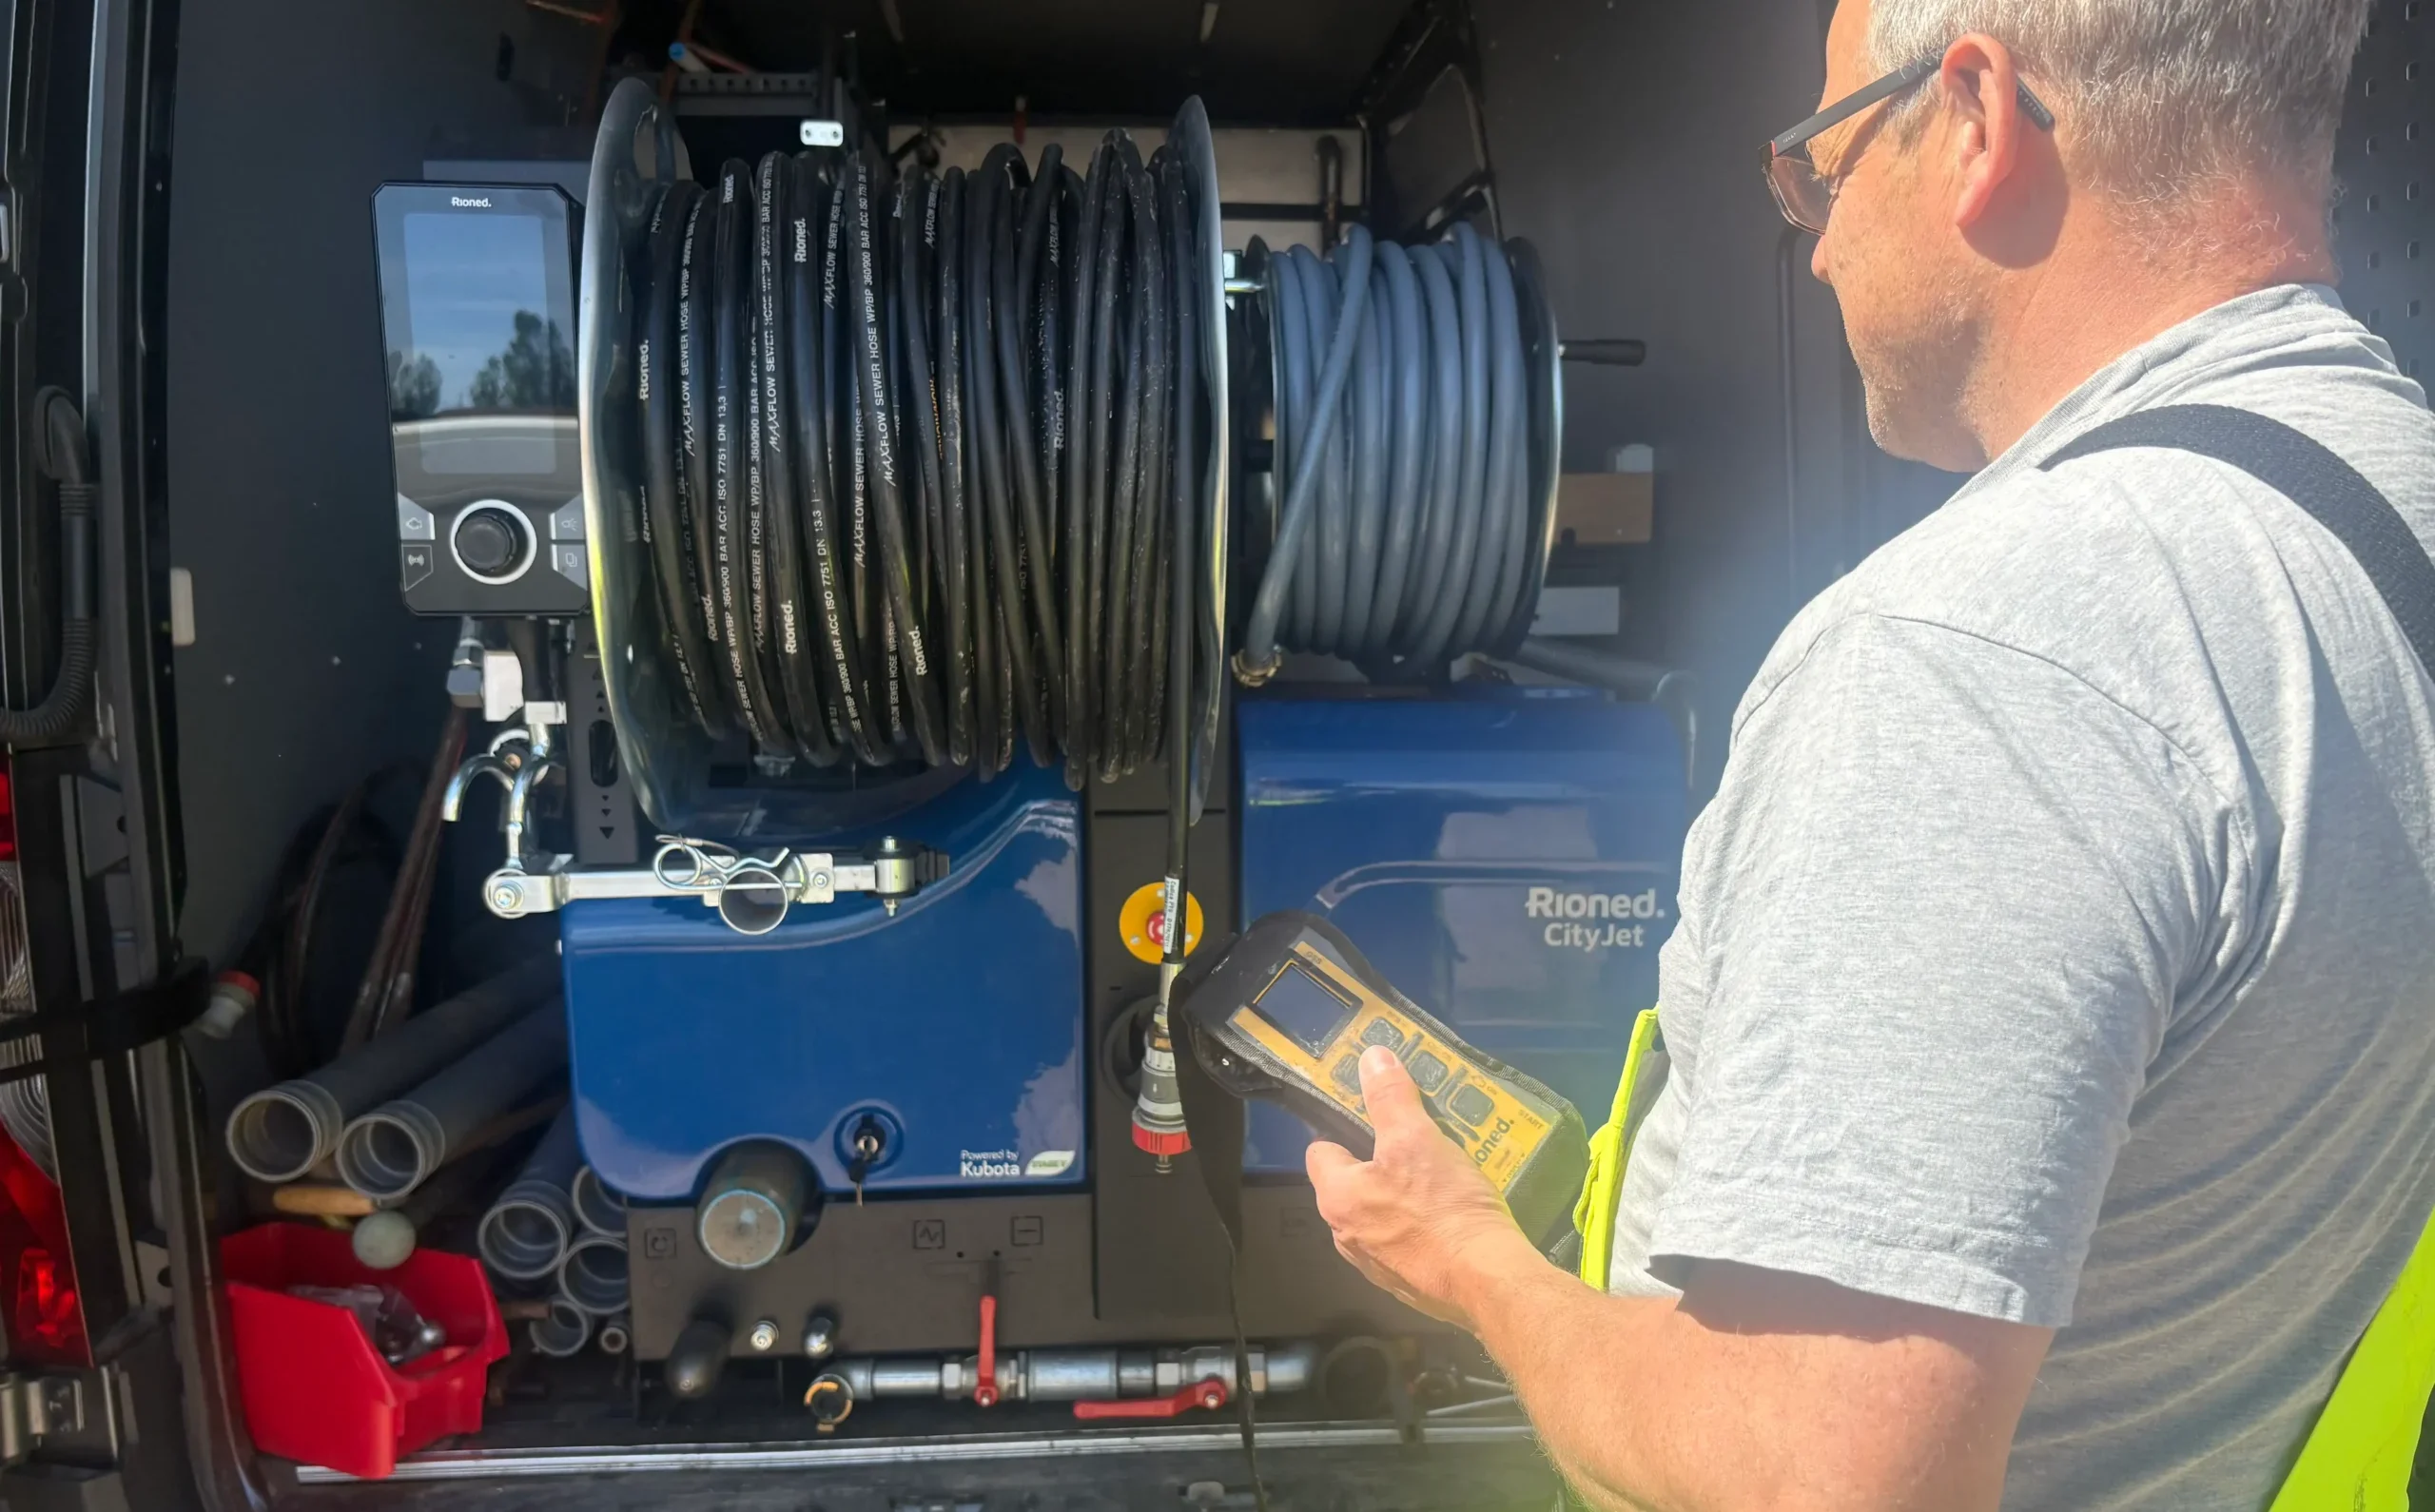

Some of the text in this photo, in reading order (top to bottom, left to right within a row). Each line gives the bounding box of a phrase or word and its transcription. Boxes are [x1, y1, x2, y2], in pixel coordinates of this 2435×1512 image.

[451, 197, 492, 207] Rioned.
[763, 190, 771, 204] ACC
[859, 198, 867, 209] ISO
[762, 206, 770, 223] BAR
[830, 204, 841, 222] HOSE
[860, 211, 869, 228] ACC
[925, 208, 936, 248] MAXFLOW
[795, 218, 807, 262] Rioned.
[828, 223, 838, 248] SEWER
[862, 230, 870, 248] BAR
[825, 251, 836, 310] MAXFLOW
[863, 252, 873, 285] 360/900
[866, 288, 876, 322] WP/BP
[868, 327, 879, 359] HOSE
[639, 339, 650, 400] Rioned.
[873, 363, 885, 406] SEWER
[682, 380, 695, 456] MAXFLOW
[719, 396, 728, 418] 13,3
[768, 377, 780, 452] MAXFLOW
[1054, 387, 1064, 450] Rioned.
[719, 424, 726, 441] DN
[751, 418, 760, 461] 360/900
[855, 409, 865, 441] HOSE
[877, 412, 896, 486] MAXFLOW
[856, 448, 865, 492] SEWER
[751, 467, 760, 506] WP/BP
[817, 538, 827, 556] DN
[854, 496, 866, 568] MAXFLOW
[721, 566, 731, 608] 360/900
[821, 562, 830, 586] 7751
[826, 591, 835, 610] ISO
[726, 611, 736, 647] WP/BP
[754, 594, 765, 652] MAXFLOW
[782, 600, 797, 654] Rioned.
[829, 613, 840, 635] ACC
[731, 649, 743, 678] HOSE
[833, 639, 845, 660] BAR
[909, 626, 927, 675] Rioned.
[839, 663, 852, 693] 360/900
[889, 654, 898, 678] HOSE
[737, 680, 751, 708] SEWER
[890, 680, 899, 704] SEWER
[1525, 886, 1666, 919] Rioned.
[1544, 922, 1645, 953] CityJet
[1518, 1109, 1545, 1130] START
[960, 1149, 1019, 1161] Powered by
[1473, 1116, 1514, 1167] oned.
[960, 1160, 1021, 1177] Kubota
